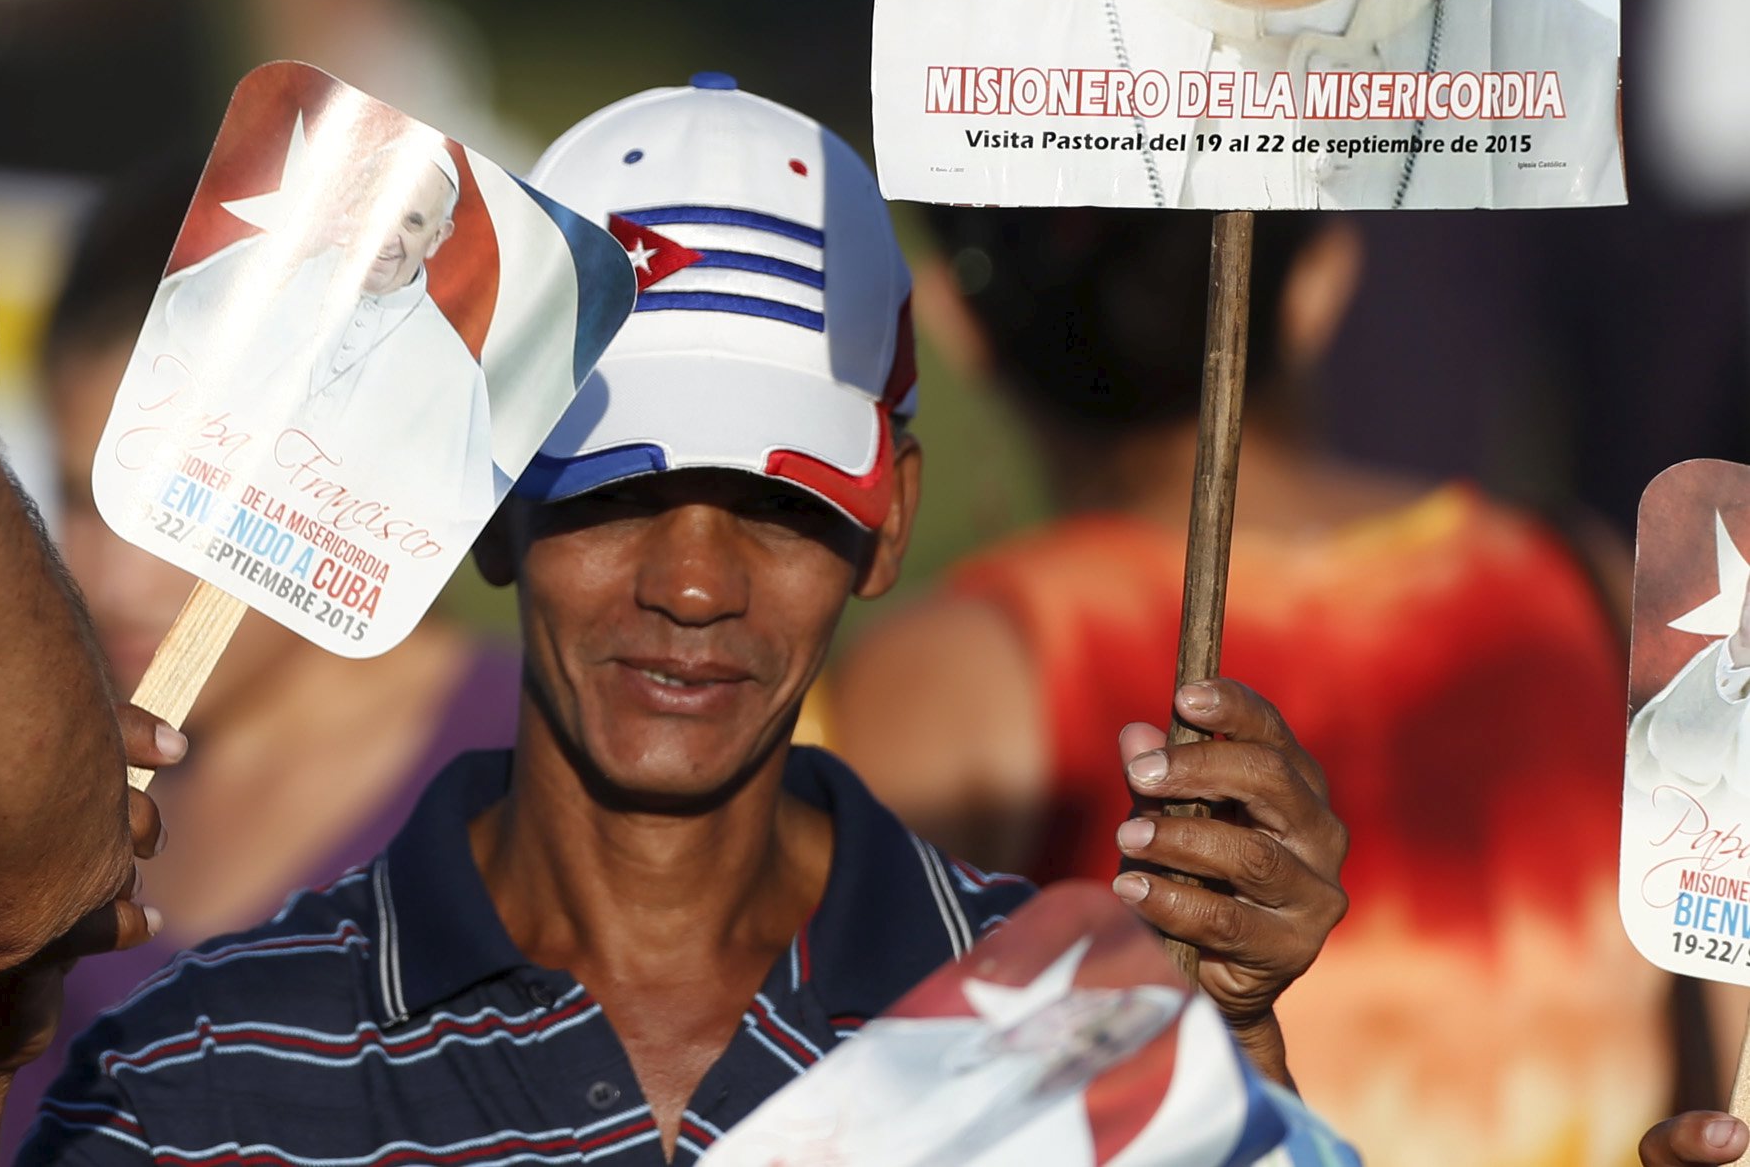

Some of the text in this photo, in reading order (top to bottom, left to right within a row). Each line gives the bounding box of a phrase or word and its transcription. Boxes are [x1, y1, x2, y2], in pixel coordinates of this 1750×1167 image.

[925, 66, 1566, 120] MISIONERO DE LA MISERICORDIA
[965, 130, 1532, 159] Visita Pastoral del 19 al 22 de septiembre de 2015
[274, 428, 444, 560] Francisco
[240, 486, 266, 512] DE
[263, 497, 286, 523] LA
[287, 510, 391, 584] MISERICORDIA
[291, 546, 315, 581] A
[312, 557, 382, 620] CUBA
[315, 601, 368, 642] 2015
[1679, 868, 1750, 902] MISIONE
